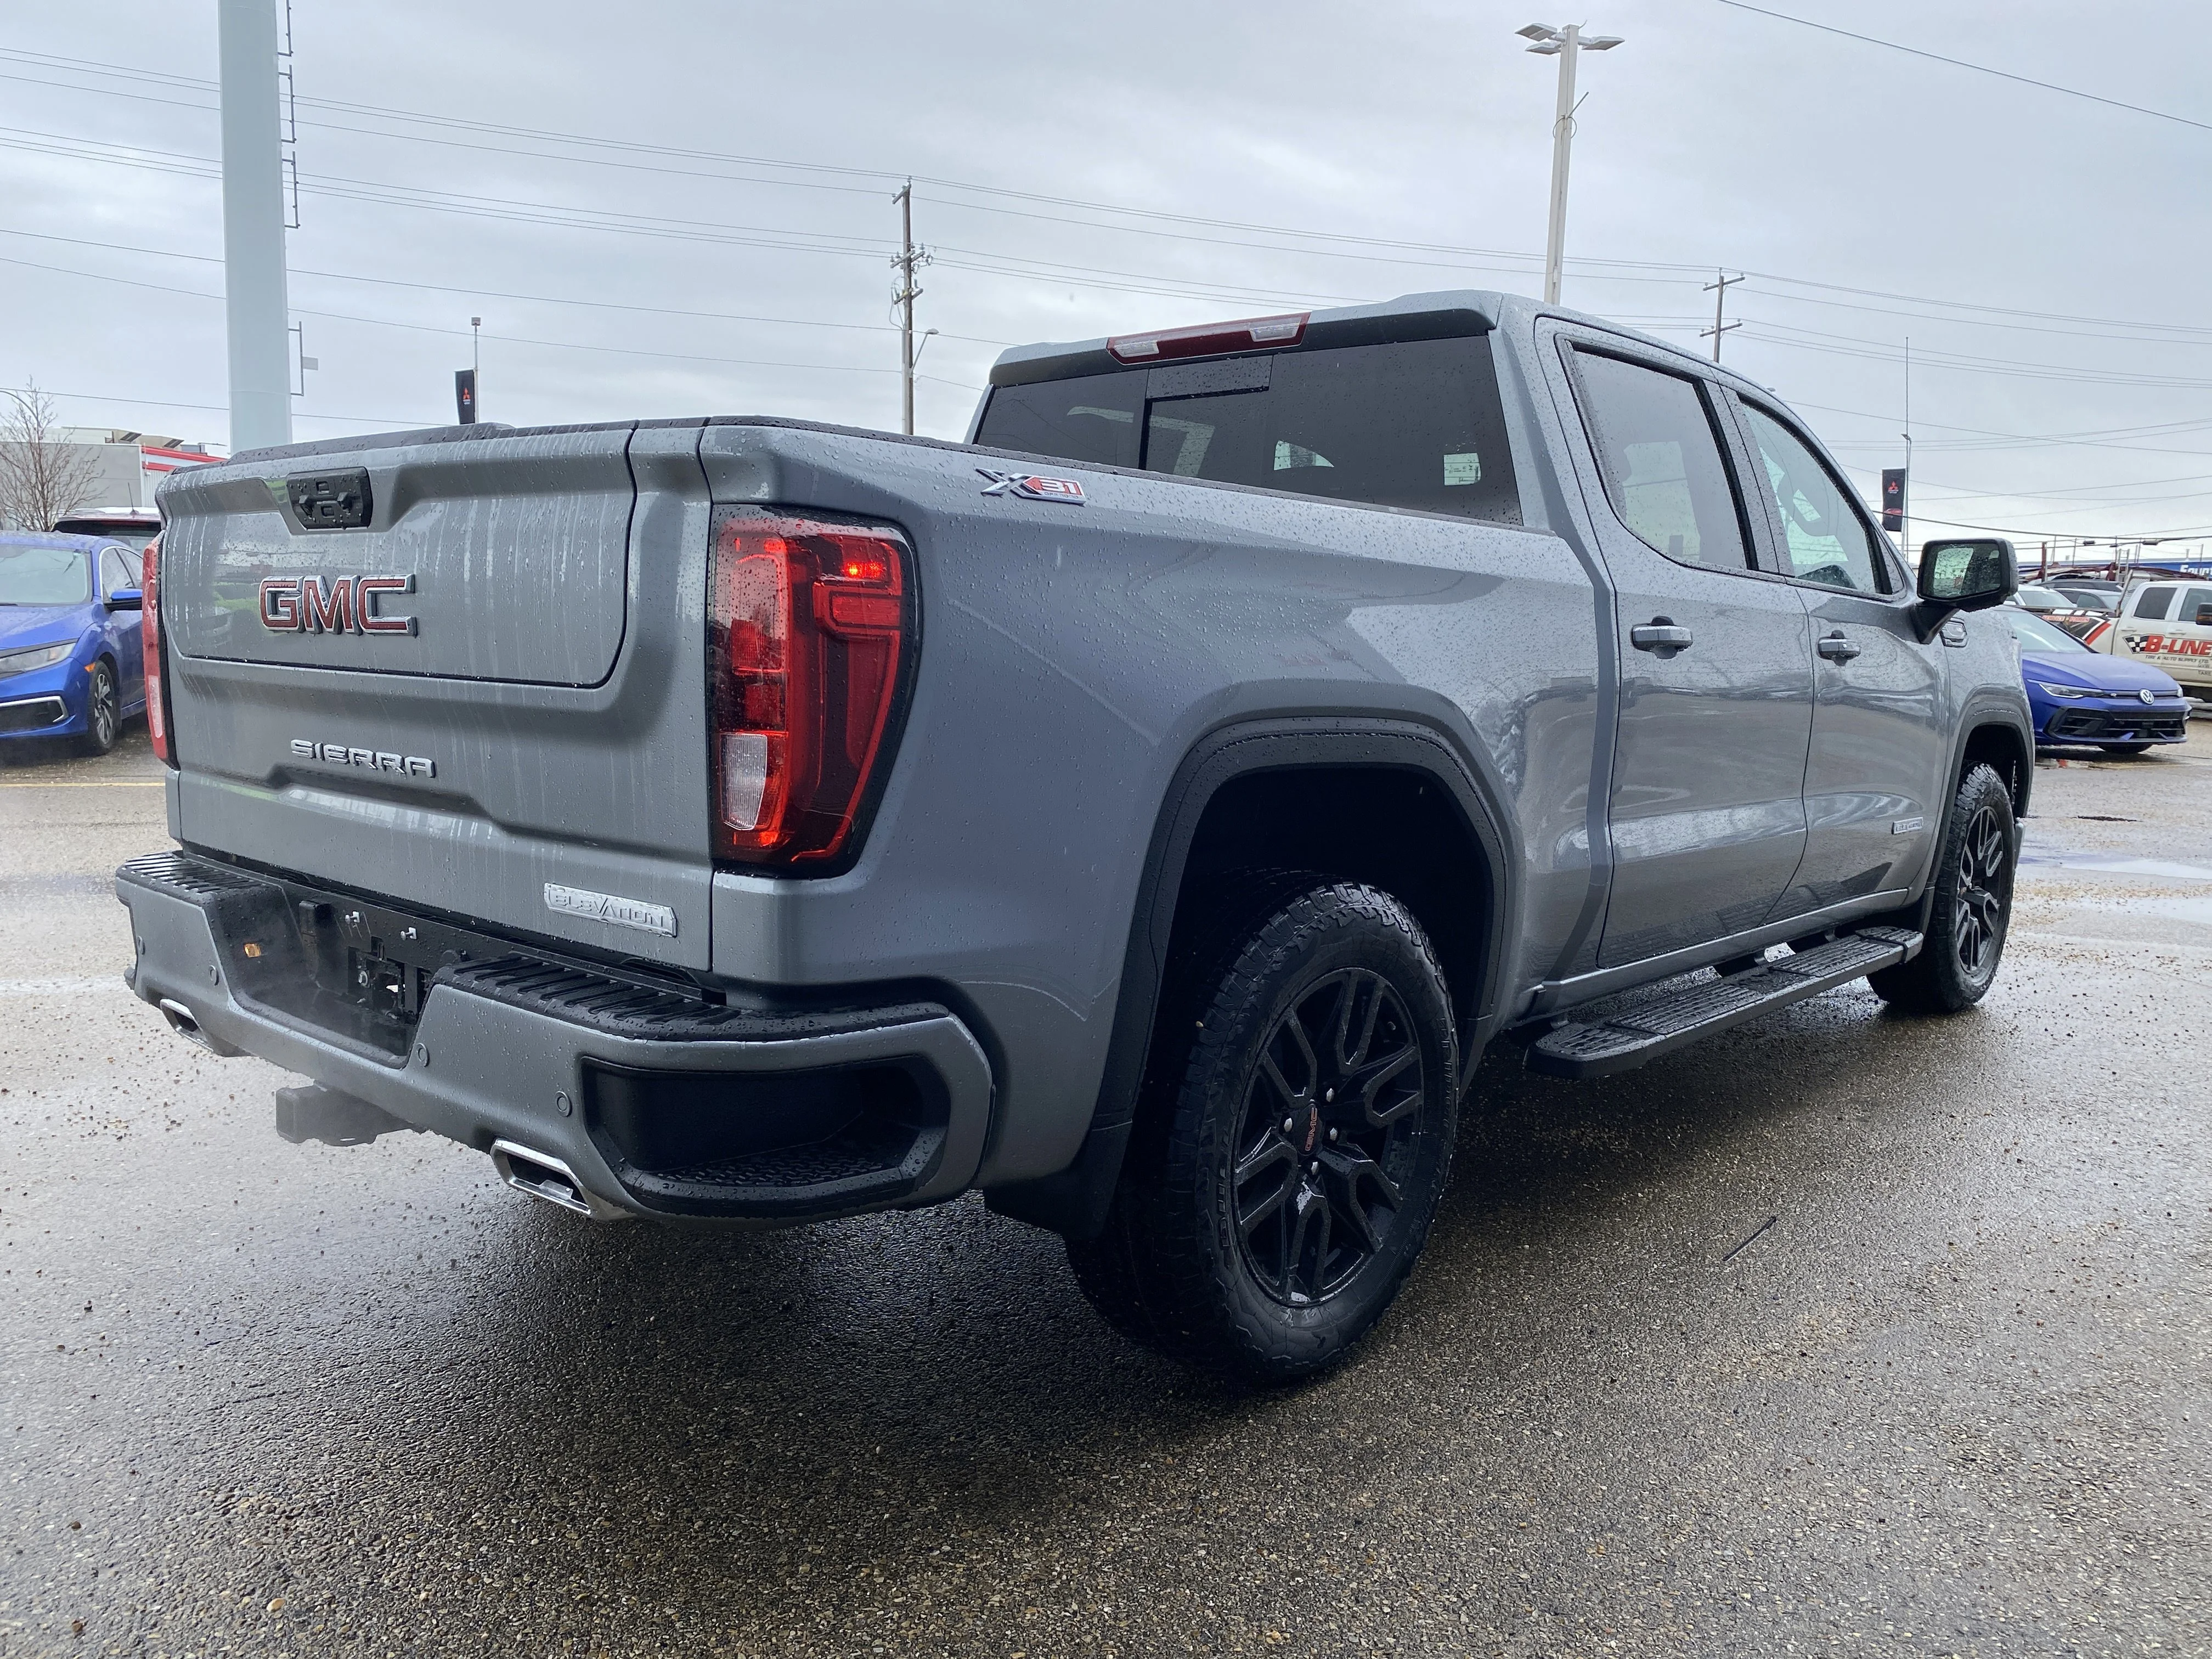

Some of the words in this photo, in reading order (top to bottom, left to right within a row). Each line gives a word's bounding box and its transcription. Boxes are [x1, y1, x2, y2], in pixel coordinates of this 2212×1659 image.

[259, 574, 417, 638] GMC
[2144, 635, 2212, 656] B-LINE
[291, 739, 436, 778] SIERRA
[1305, 1107, 1317, 1151] GMC
